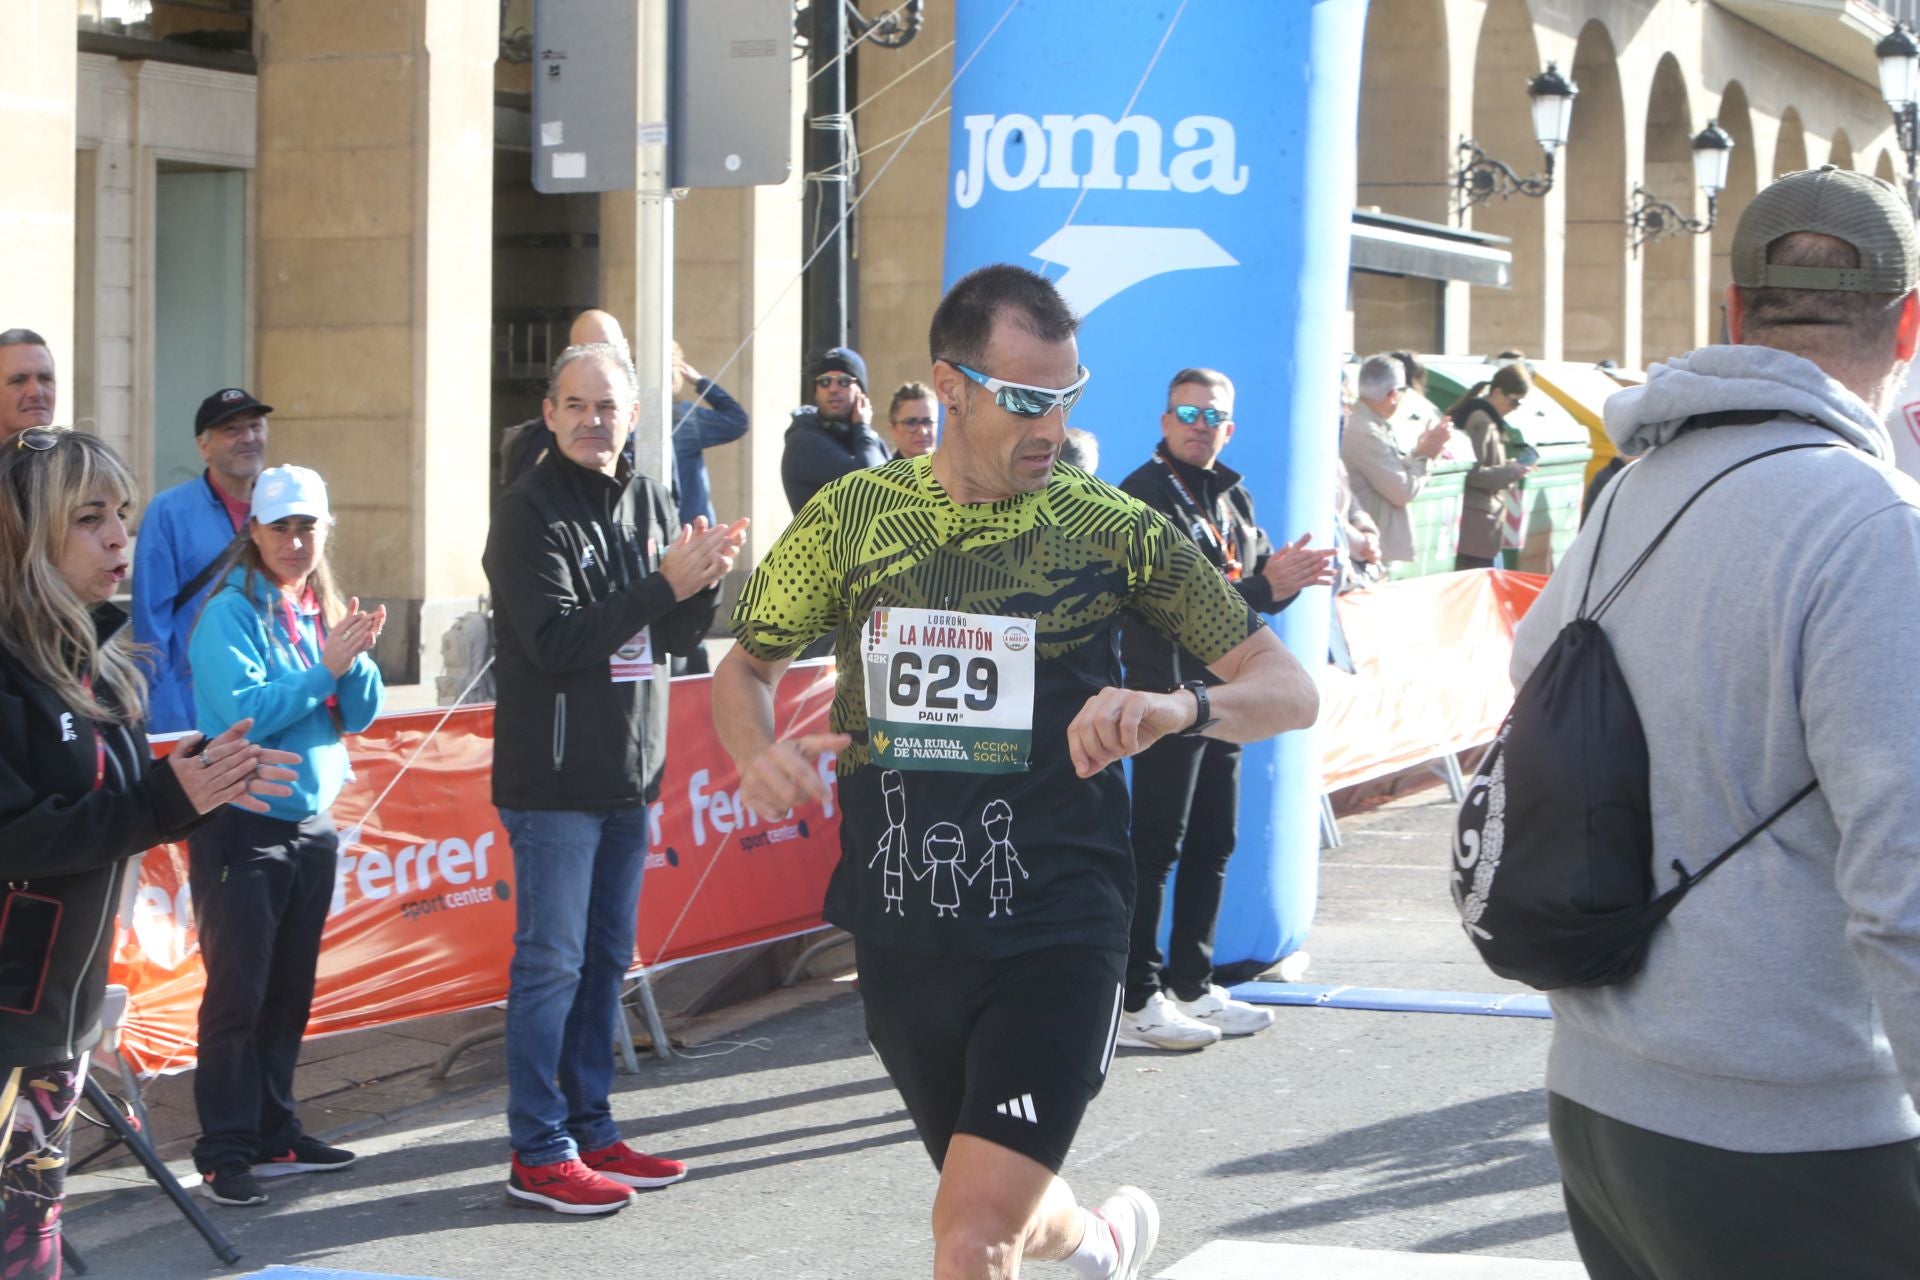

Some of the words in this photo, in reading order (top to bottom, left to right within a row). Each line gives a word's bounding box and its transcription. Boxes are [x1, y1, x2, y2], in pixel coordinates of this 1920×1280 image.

[928, 615, 967, 627] LOGROÑO
[900, 625, 916, 646] LA
[923, 627, 992, 651] MARATÓN
[867, 654, 887, 664] 42K
[889, 652, 998, 711] 629
[919, 711, 943, 721] PAU
[894, 737, 922, 748] CAJA
[924, 739, 963, 750] RURAL
[973, 741, 1017, 753] ACCIÓN
[894, 748, 909, 758] DE
[913, 749, 969, 761] NAVARRA
[973, 752, 1017, 762] SOCIAL
[401, 885, 494, 919] sportcenter
